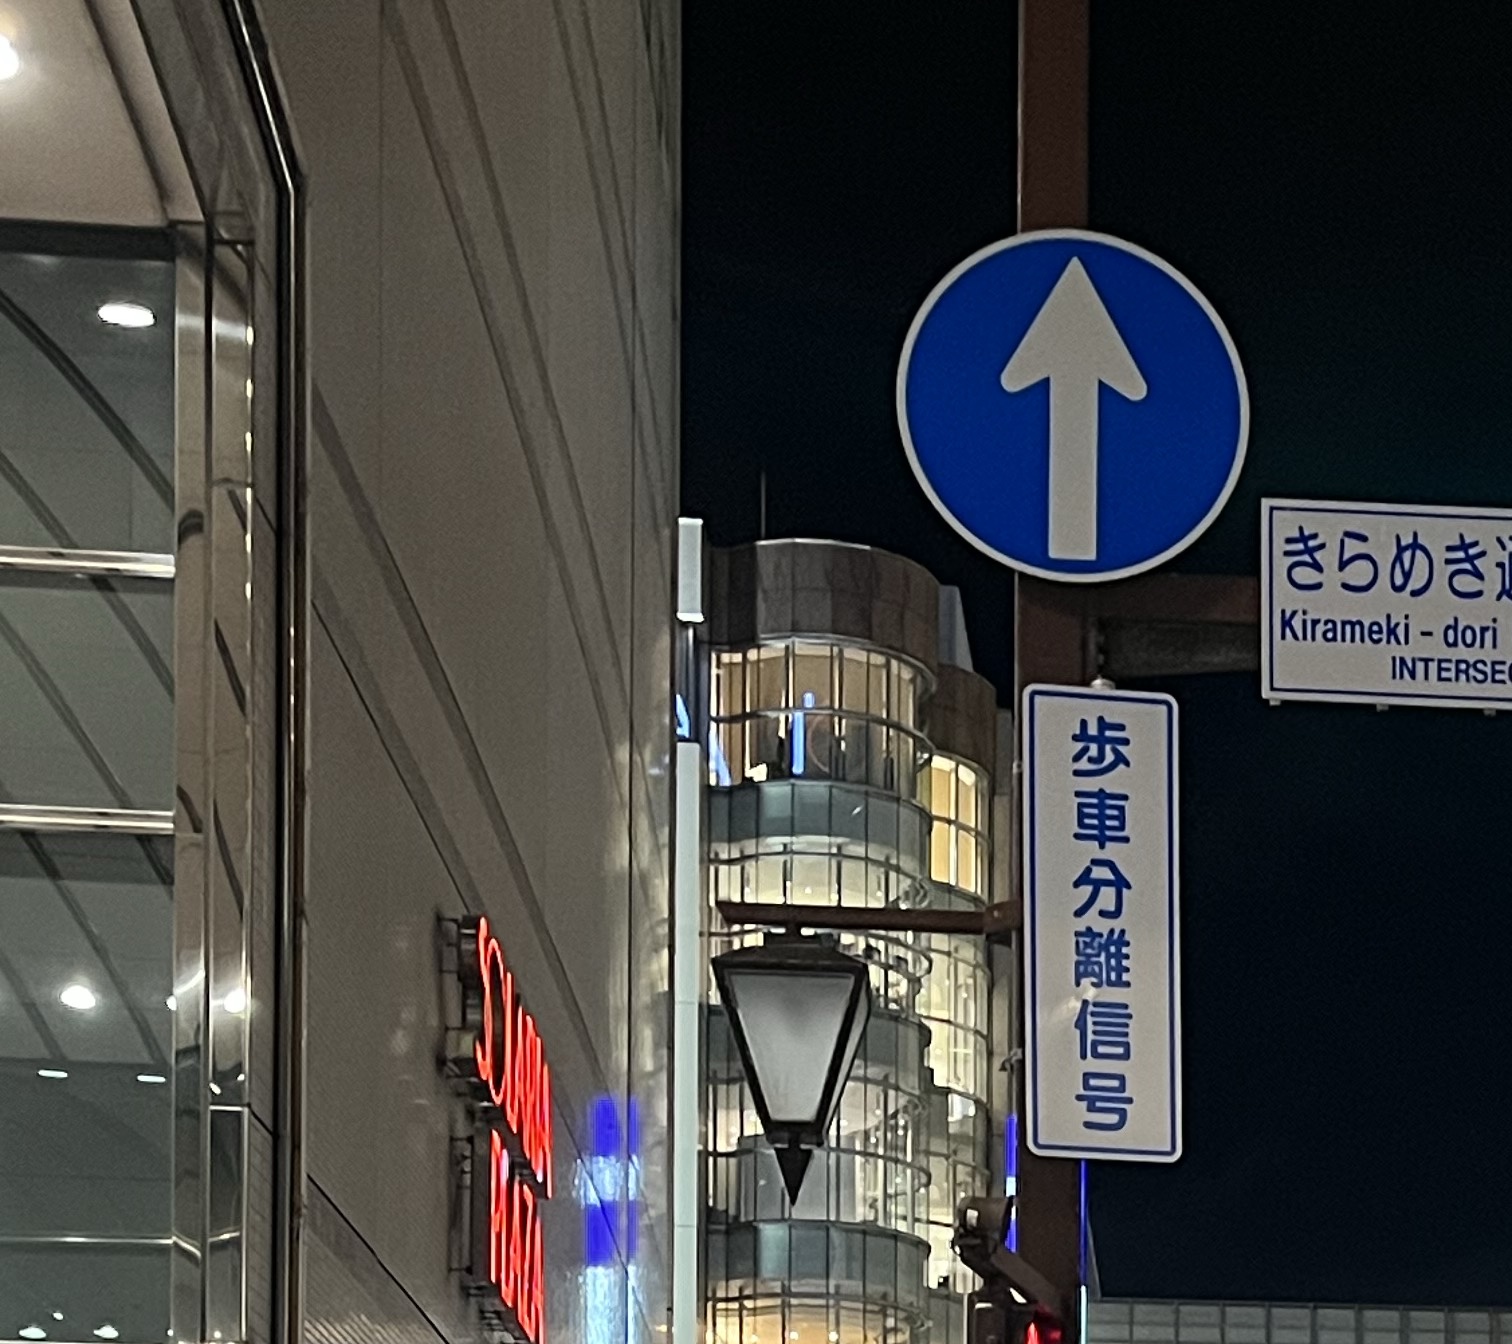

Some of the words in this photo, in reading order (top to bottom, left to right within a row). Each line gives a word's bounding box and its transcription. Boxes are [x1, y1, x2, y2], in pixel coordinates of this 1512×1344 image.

[1280, 609, 1411, 646] Kirameki
[1443, 616, 1498, 650] dori
[475, 917, 553, 1199] SOLARIA
[1071, 715, 1134, 1132] 歩車分離信号
